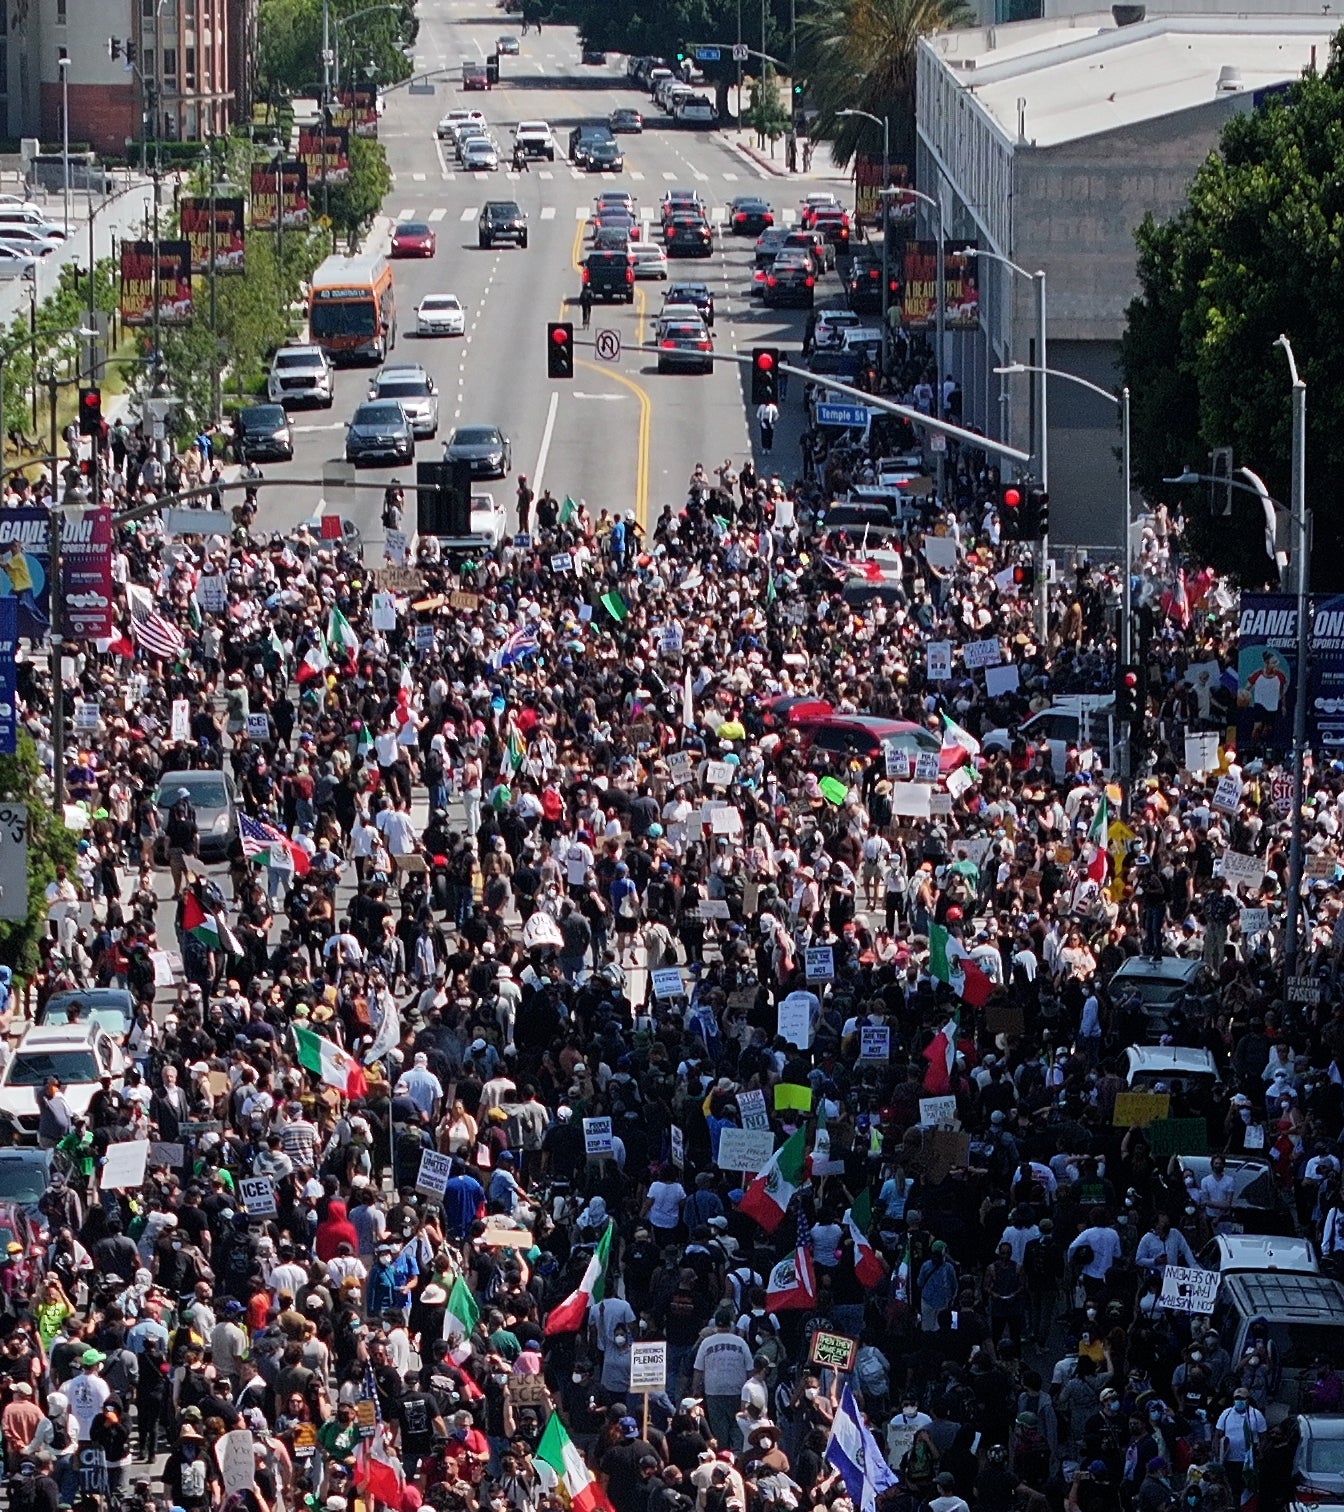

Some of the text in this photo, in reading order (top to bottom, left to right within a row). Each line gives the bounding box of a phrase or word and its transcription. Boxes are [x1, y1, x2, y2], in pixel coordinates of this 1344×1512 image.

[912, 280, 964, 297] BEAUIFUL
[822, 407, 864, 423] Temple St
[62, 520, 94, 543] ON!
[1240, 609, 1298, 636] GAME
[1312, 638, 1340, 650] SPORTS
[1273, 784, 1294, 798] STO
[242, 1182, 270, 1199] ICE:
[633, 1355, 664, 1365] PLENOS
[508, 1374, 540, 1386] FUCK
[507, 1388, 542, 1404] ICE
